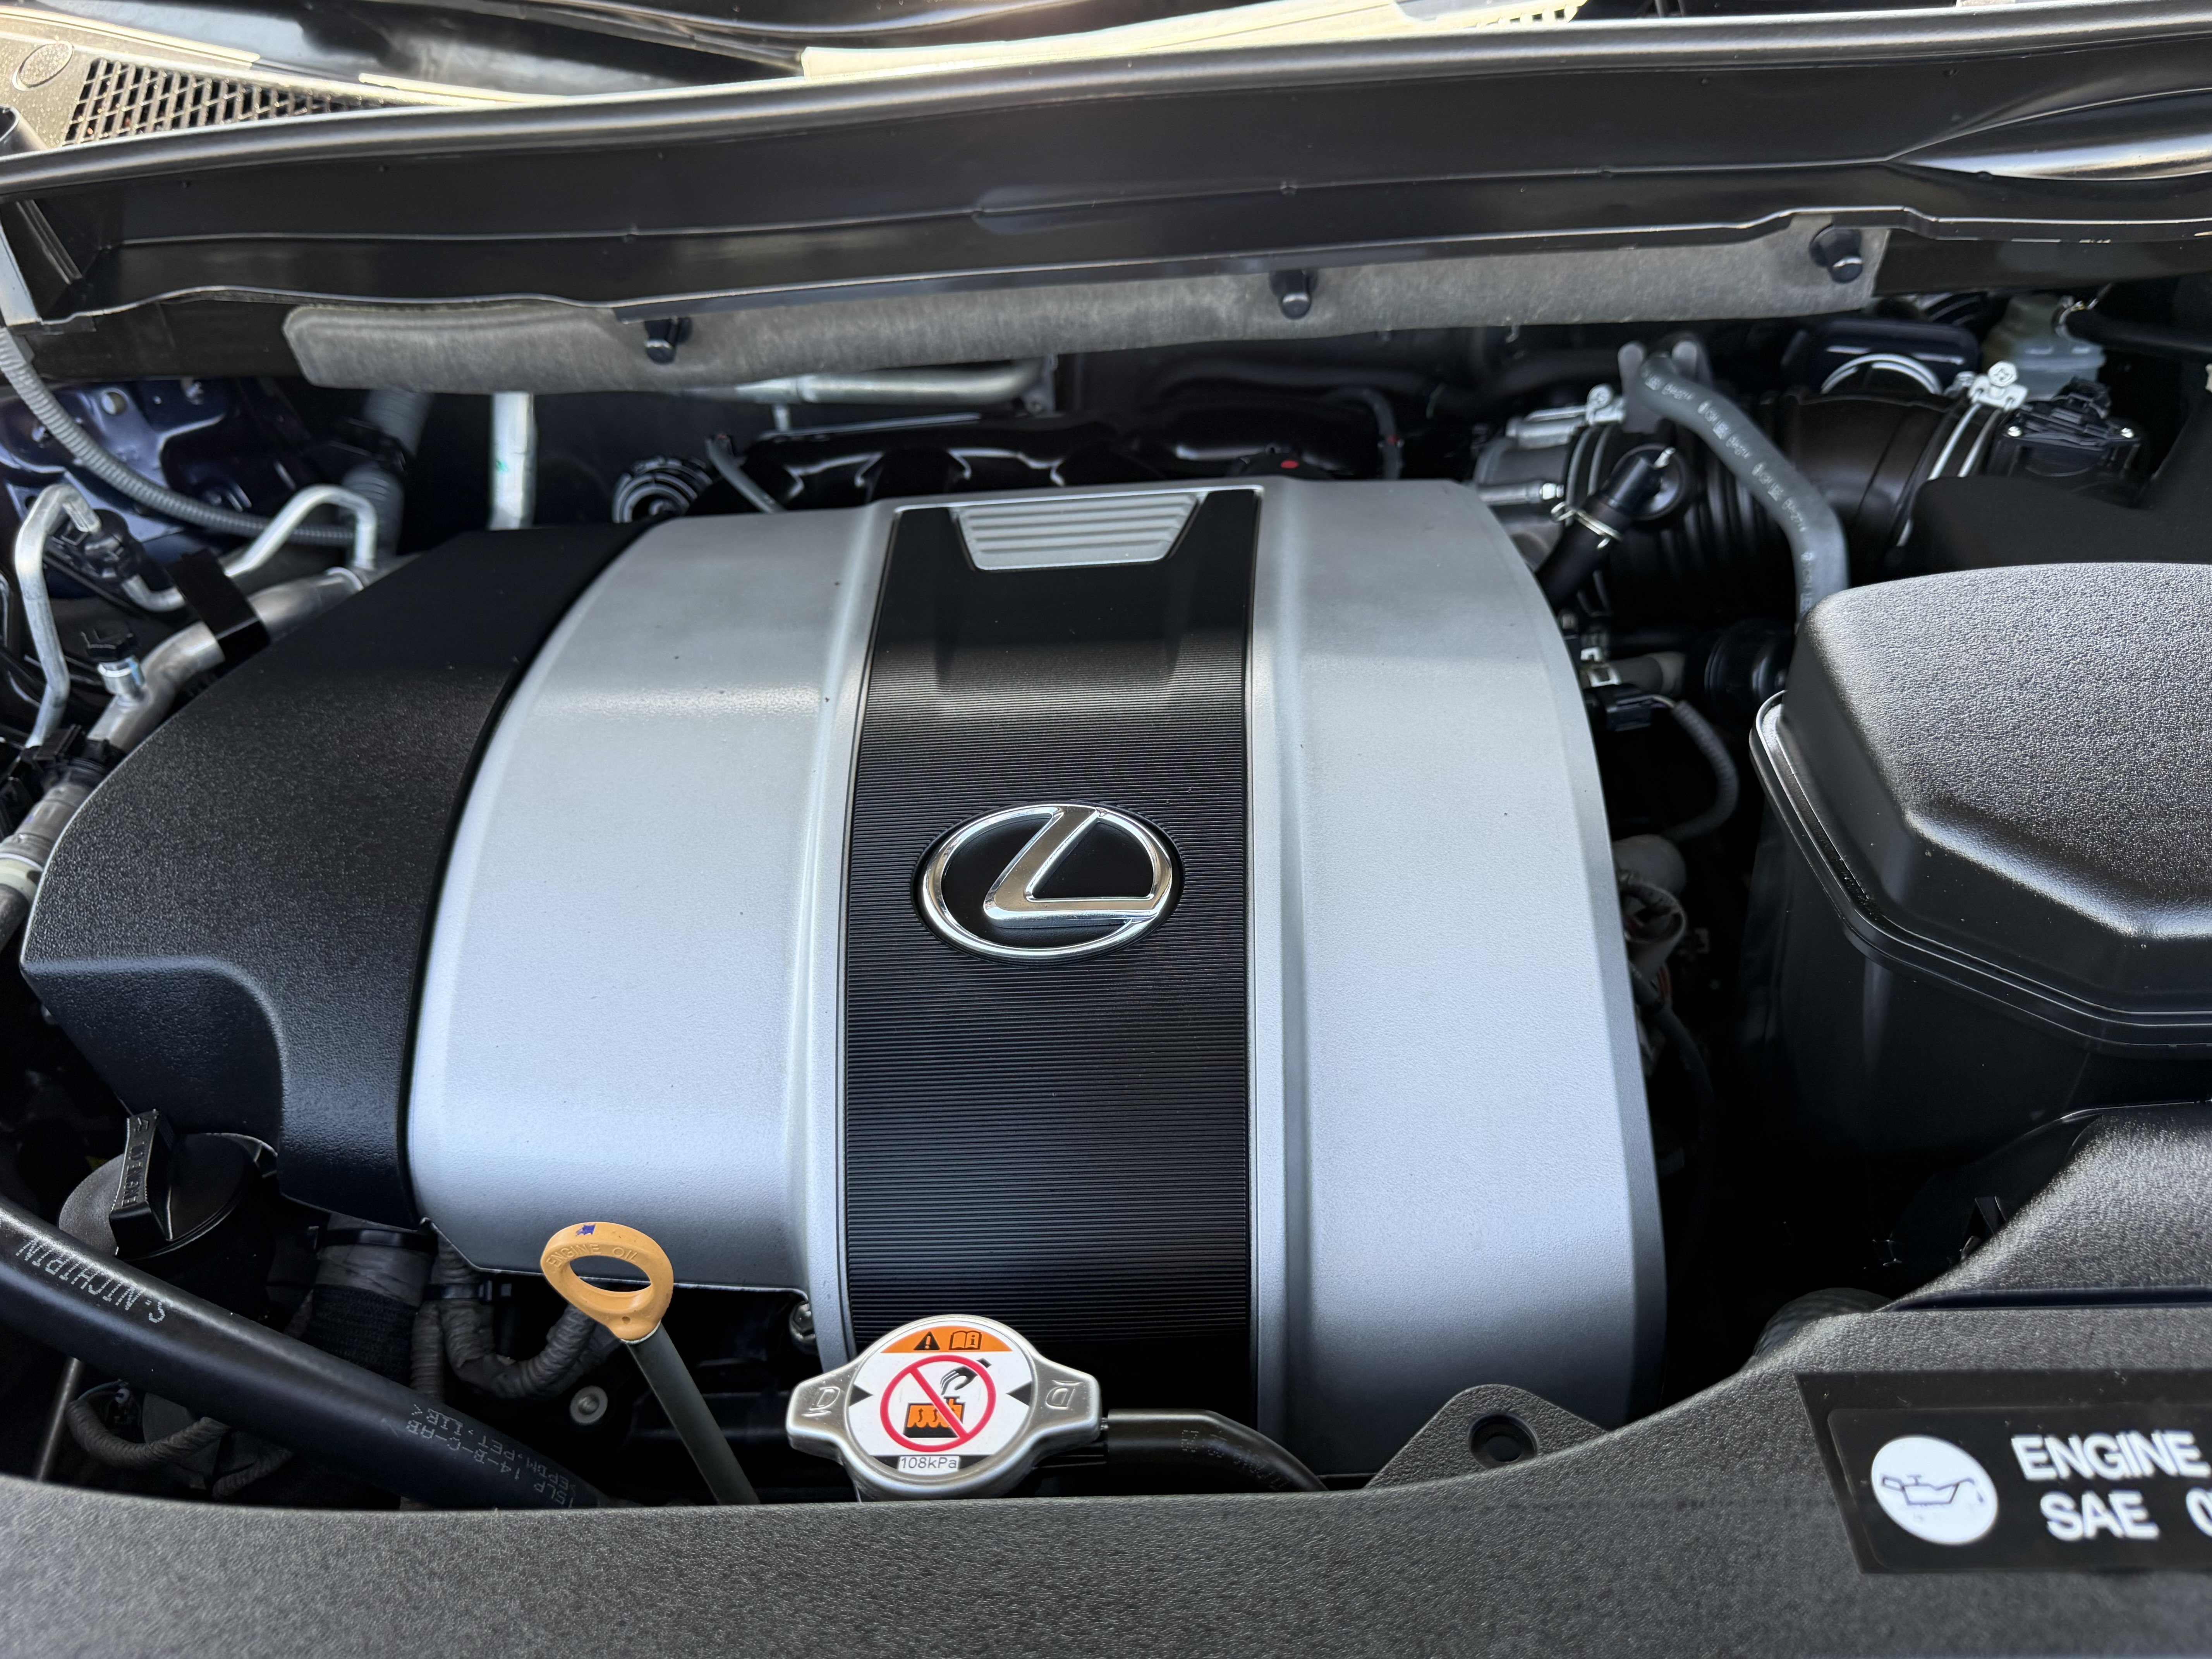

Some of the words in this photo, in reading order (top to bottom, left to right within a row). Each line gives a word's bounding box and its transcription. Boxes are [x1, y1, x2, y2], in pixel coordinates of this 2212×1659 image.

[546, 1243, 601, 1269] ENGINE
[612, 1247, 638, 1263] OIL
[901, 1456, 957, 1469] 108kPa
[2010, 1430, 2212, 1480] ENGINE
[2039, 1489, 2161, 1542] SAE
